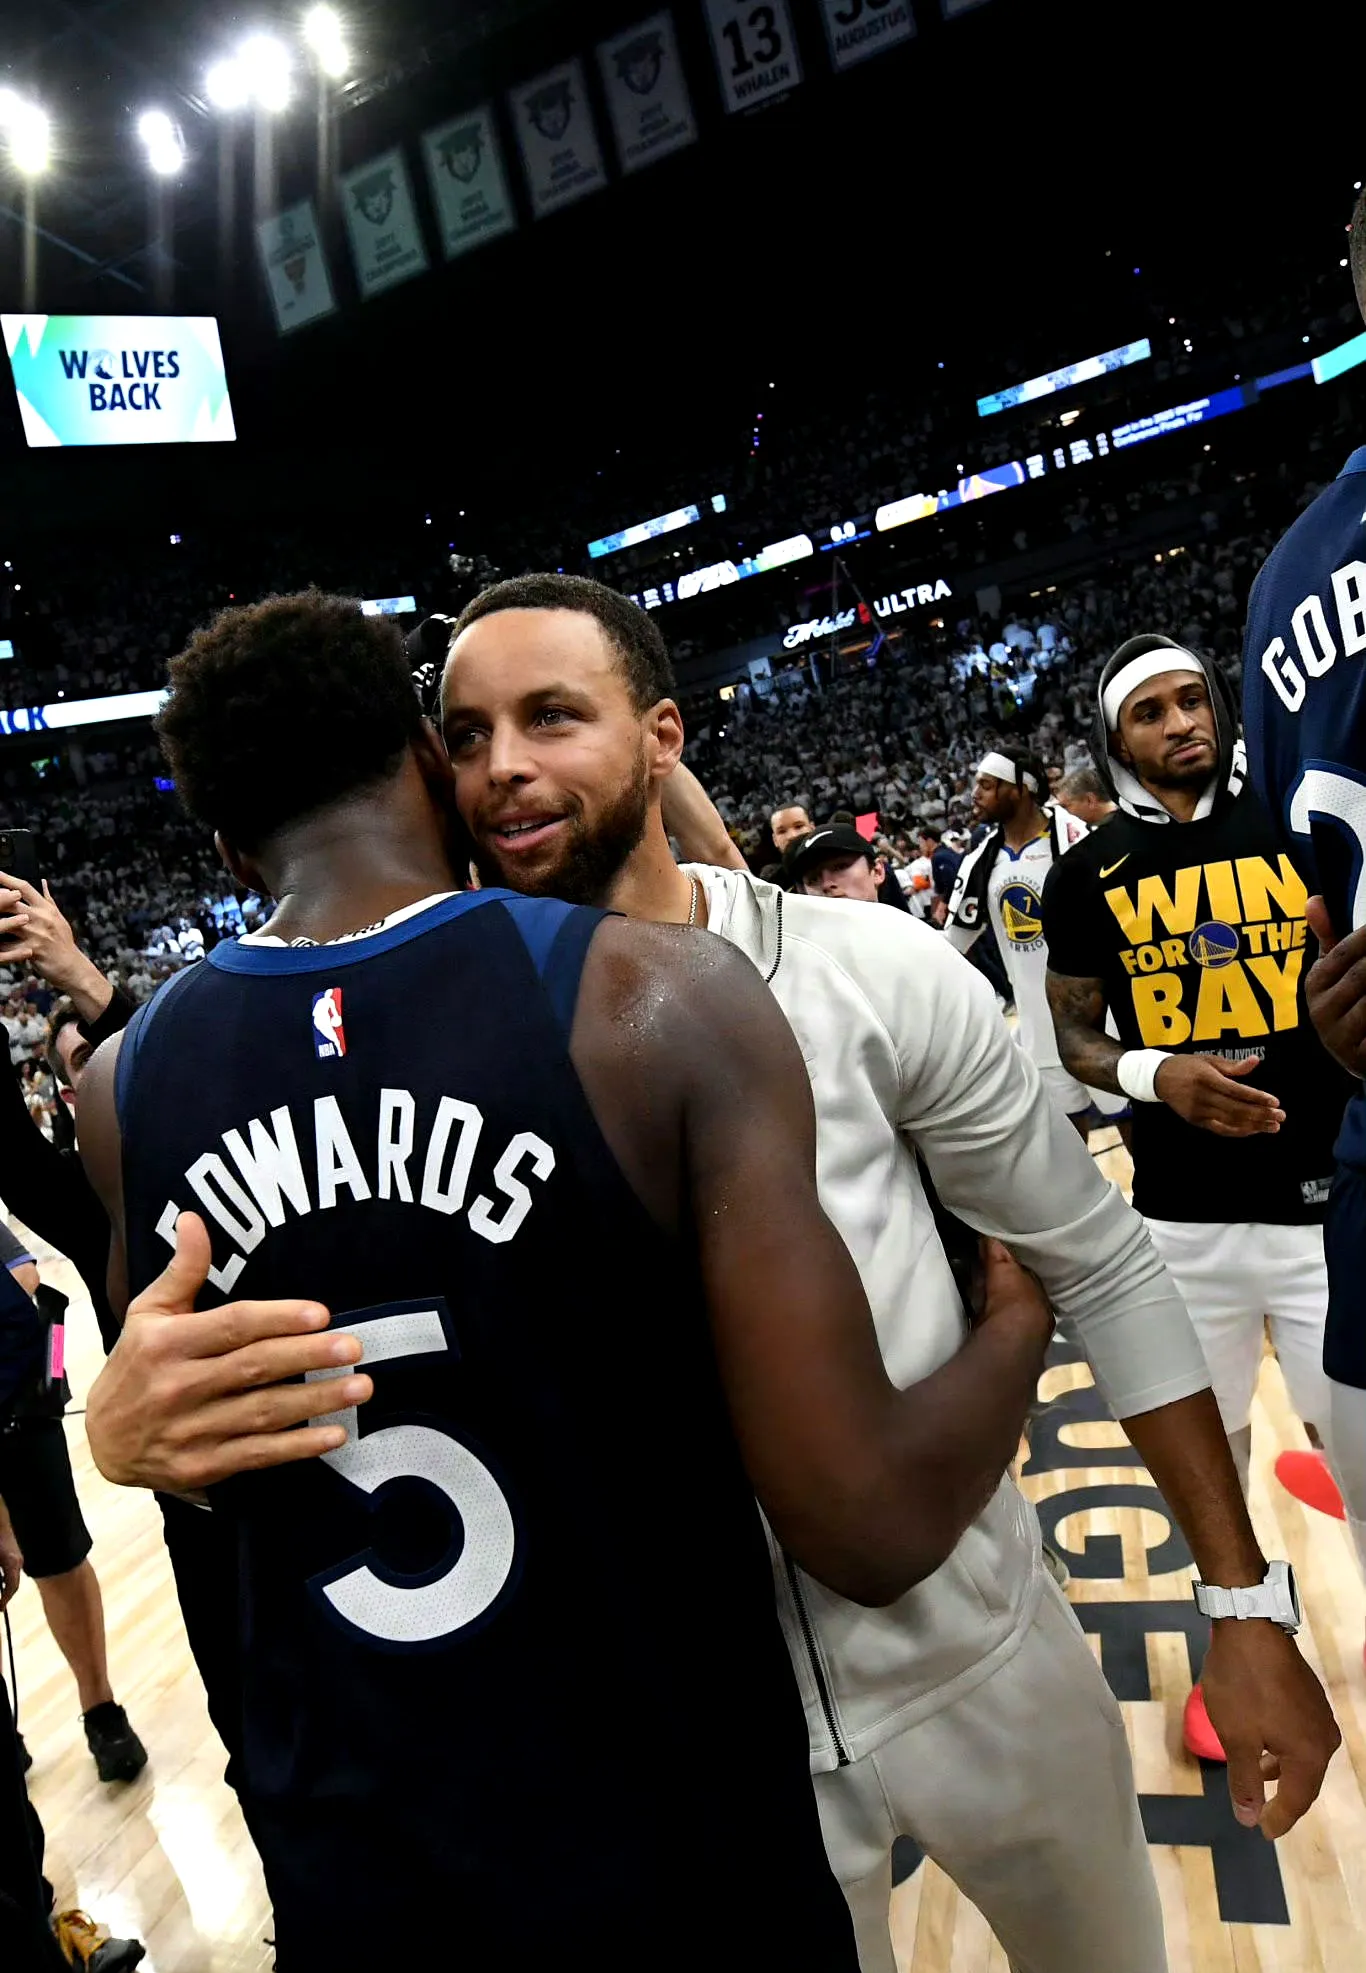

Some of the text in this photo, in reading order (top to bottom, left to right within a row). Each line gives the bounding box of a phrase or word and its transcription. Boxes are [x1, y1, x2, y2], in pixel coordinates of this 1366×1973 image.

[722, 6, 782, 76] 13
[732, 63, 790, 99] WHALEN
[89, 382, 162, 411] BACK
[873, 578, 953, 618] ULTRA
[0, 704, 48, 735] CK
[1023, 895, 1033, 914] 7
[1104, 853, 1308, 945] WIN
[1118, 920, 1308, 975] FOR THE
[1131, 948, 1306, 1047] BAY
[318, 1042, 336, 1058] NBA
[304, 1310, 515, 1642] 5
